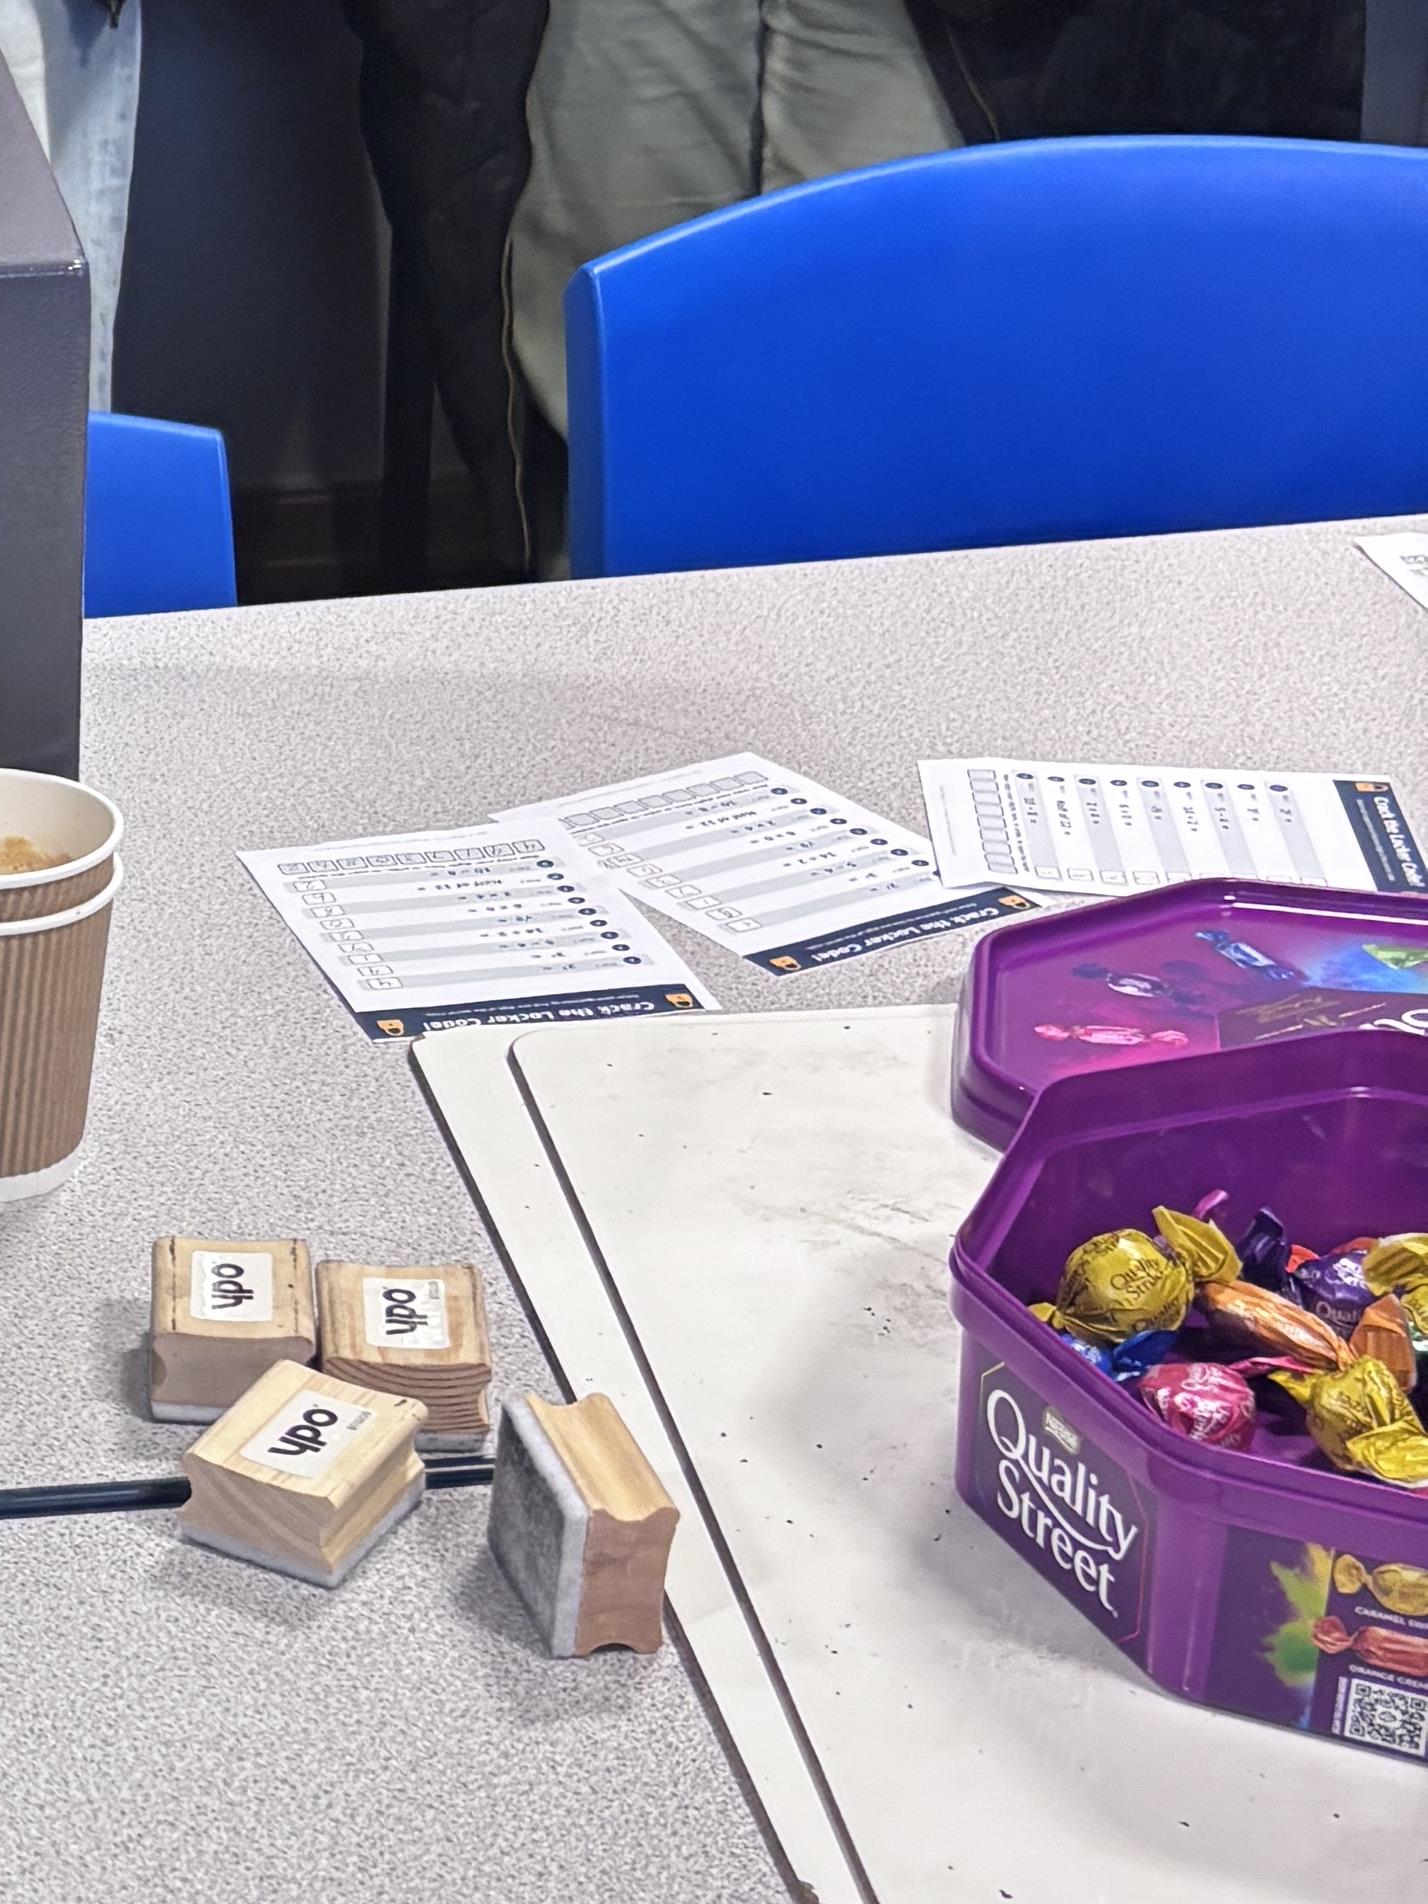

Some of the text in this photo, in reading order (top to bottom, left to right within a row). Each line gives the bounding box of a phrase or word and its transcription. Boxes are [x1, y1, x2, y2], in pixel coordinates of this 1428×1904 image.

[810, 906, 998, 963] Crack the Locker Code!
[559, 1006, 592, 1019] the
[599, 1000, 655, 1016] Crack
[210, 1262, 255, 1311] ypo
[383, 1286, 428, 1336] ypo
[267, 1407, 338, 1458] ypo
[987, 1389, 1138, 1561] Quality
[997, 1459, 1118, 1617] Street
